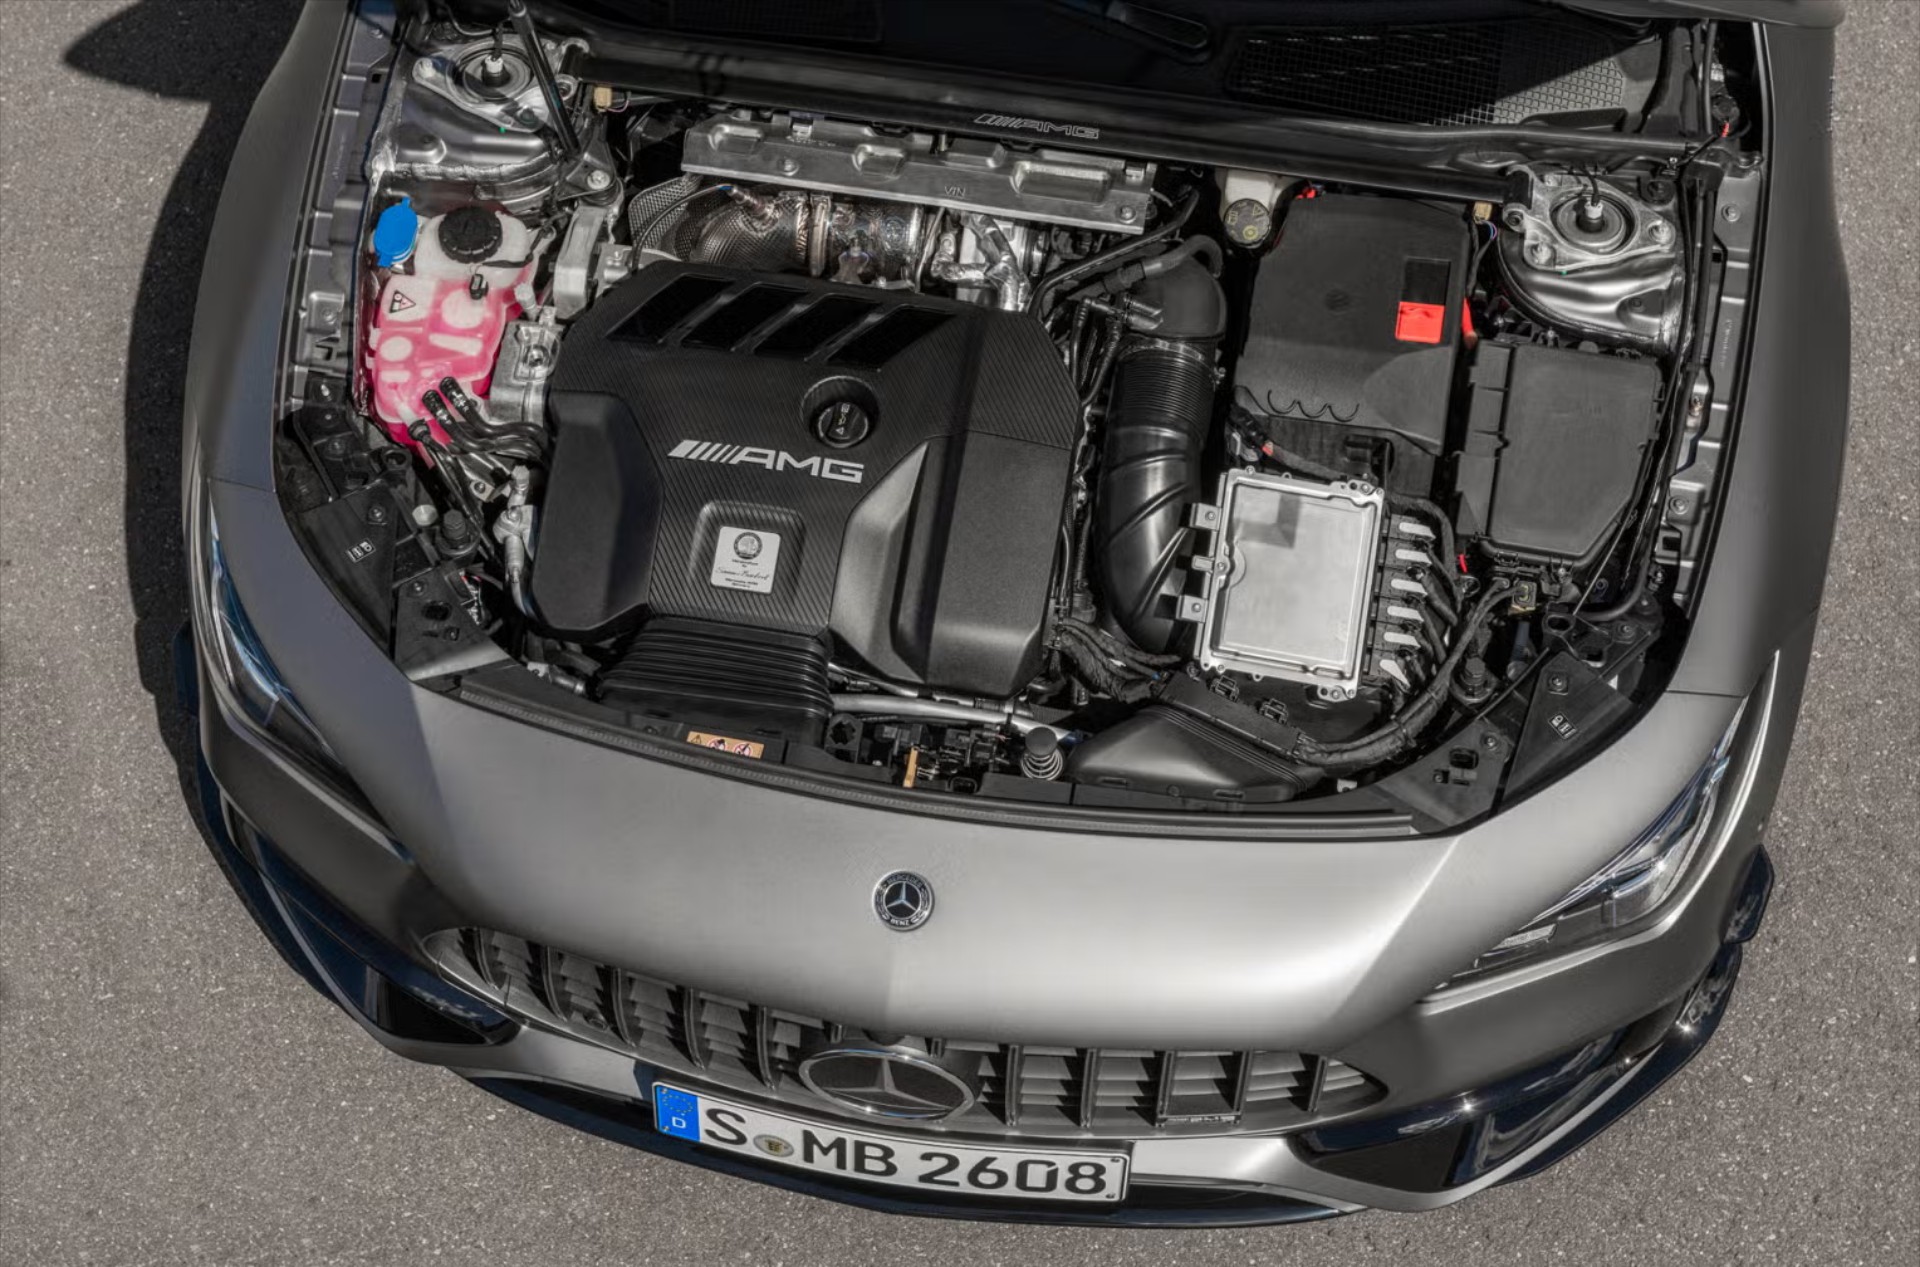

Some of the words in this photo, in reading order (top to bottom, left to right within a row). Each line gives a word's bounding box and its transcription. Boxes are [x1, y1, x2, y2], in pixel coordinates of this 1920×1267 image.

[728, 446, 865, 484] AMG
[671, 1116, 687, 1129] D
[704, 1108, 748, 1146] S
[802, 1129, 898, 1177] MB
[918, 1151, 1107, 1195] 2608
